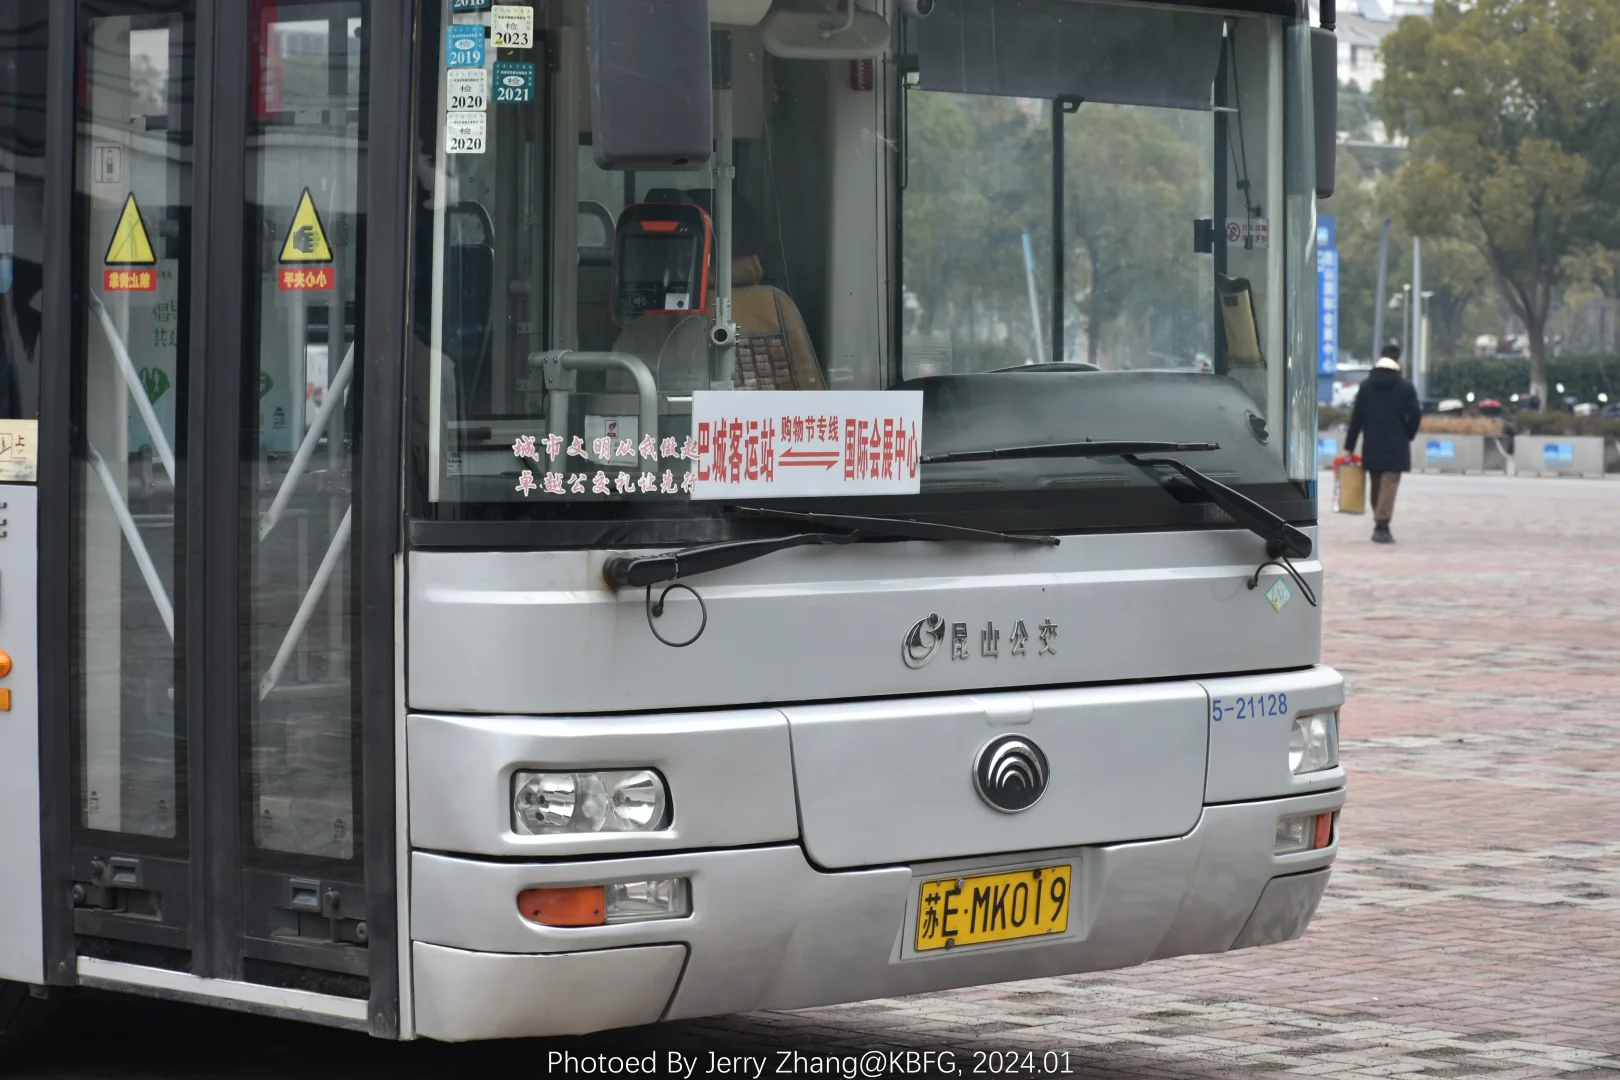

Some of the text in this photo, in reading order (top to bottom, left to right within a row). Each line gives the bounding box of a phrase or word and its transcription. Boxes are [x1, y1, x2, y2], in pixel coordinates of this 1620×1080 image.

[495, 32, 528, 46] 2023
[450, 51, 481, 65] 2019
[451, 96, 483, 109] 2020
[496, 87, 529, 101] 2021
[450, 138, 482, 150] 2020
[780, 414, 839, 444] 购物节专线
[512, 433, 701, 462] 城市文明从我做起
[697, 417, 775, 483] 巴城客运站
[844, 416, 919, 482] 国际会展中心
[515, 468, 700, 498] 卓越公交礼让先行
[951, 617, 1059, 661] 昆山公交
[1212, 692, 1288, 722] 5-21128
